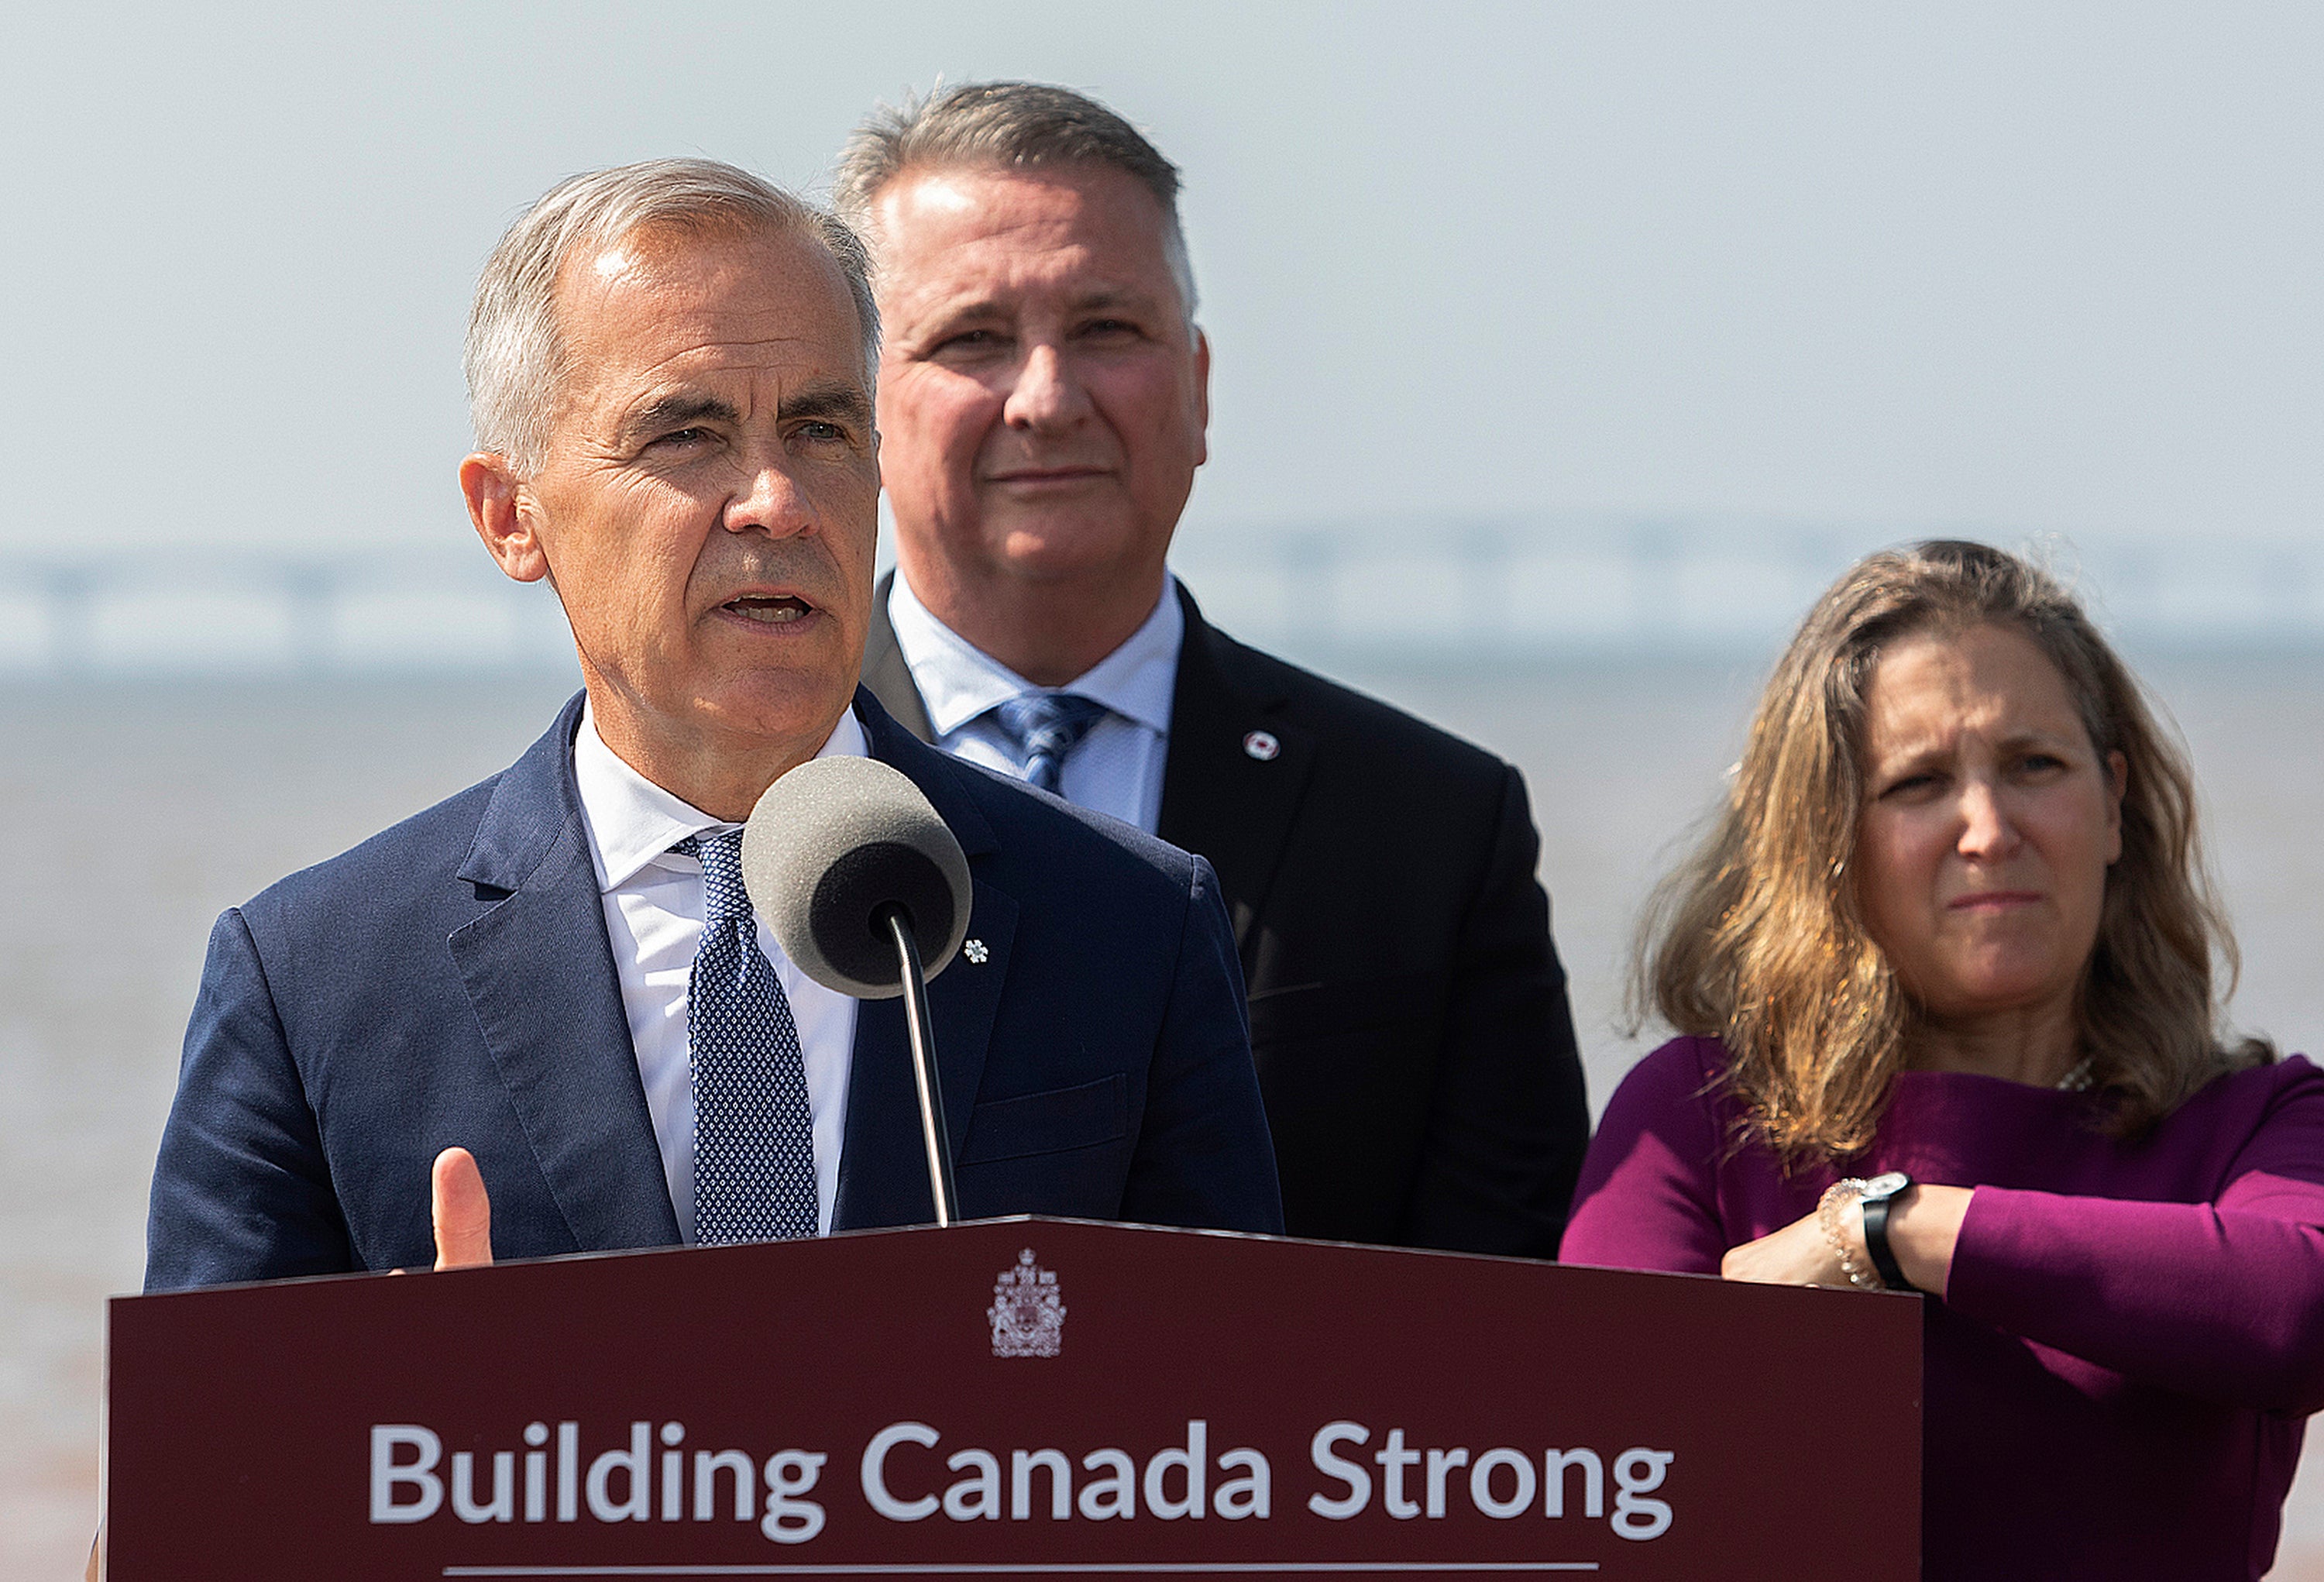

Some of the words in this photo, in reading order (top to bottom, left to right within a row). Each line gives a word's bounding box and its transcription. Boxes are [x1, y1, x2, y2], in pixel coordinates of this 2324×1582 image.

[370, 1421, 827, 1544] Building
[861, 1419, 1272, 1522] Canada
[1308, 1422, 1675, 1541] Strong
